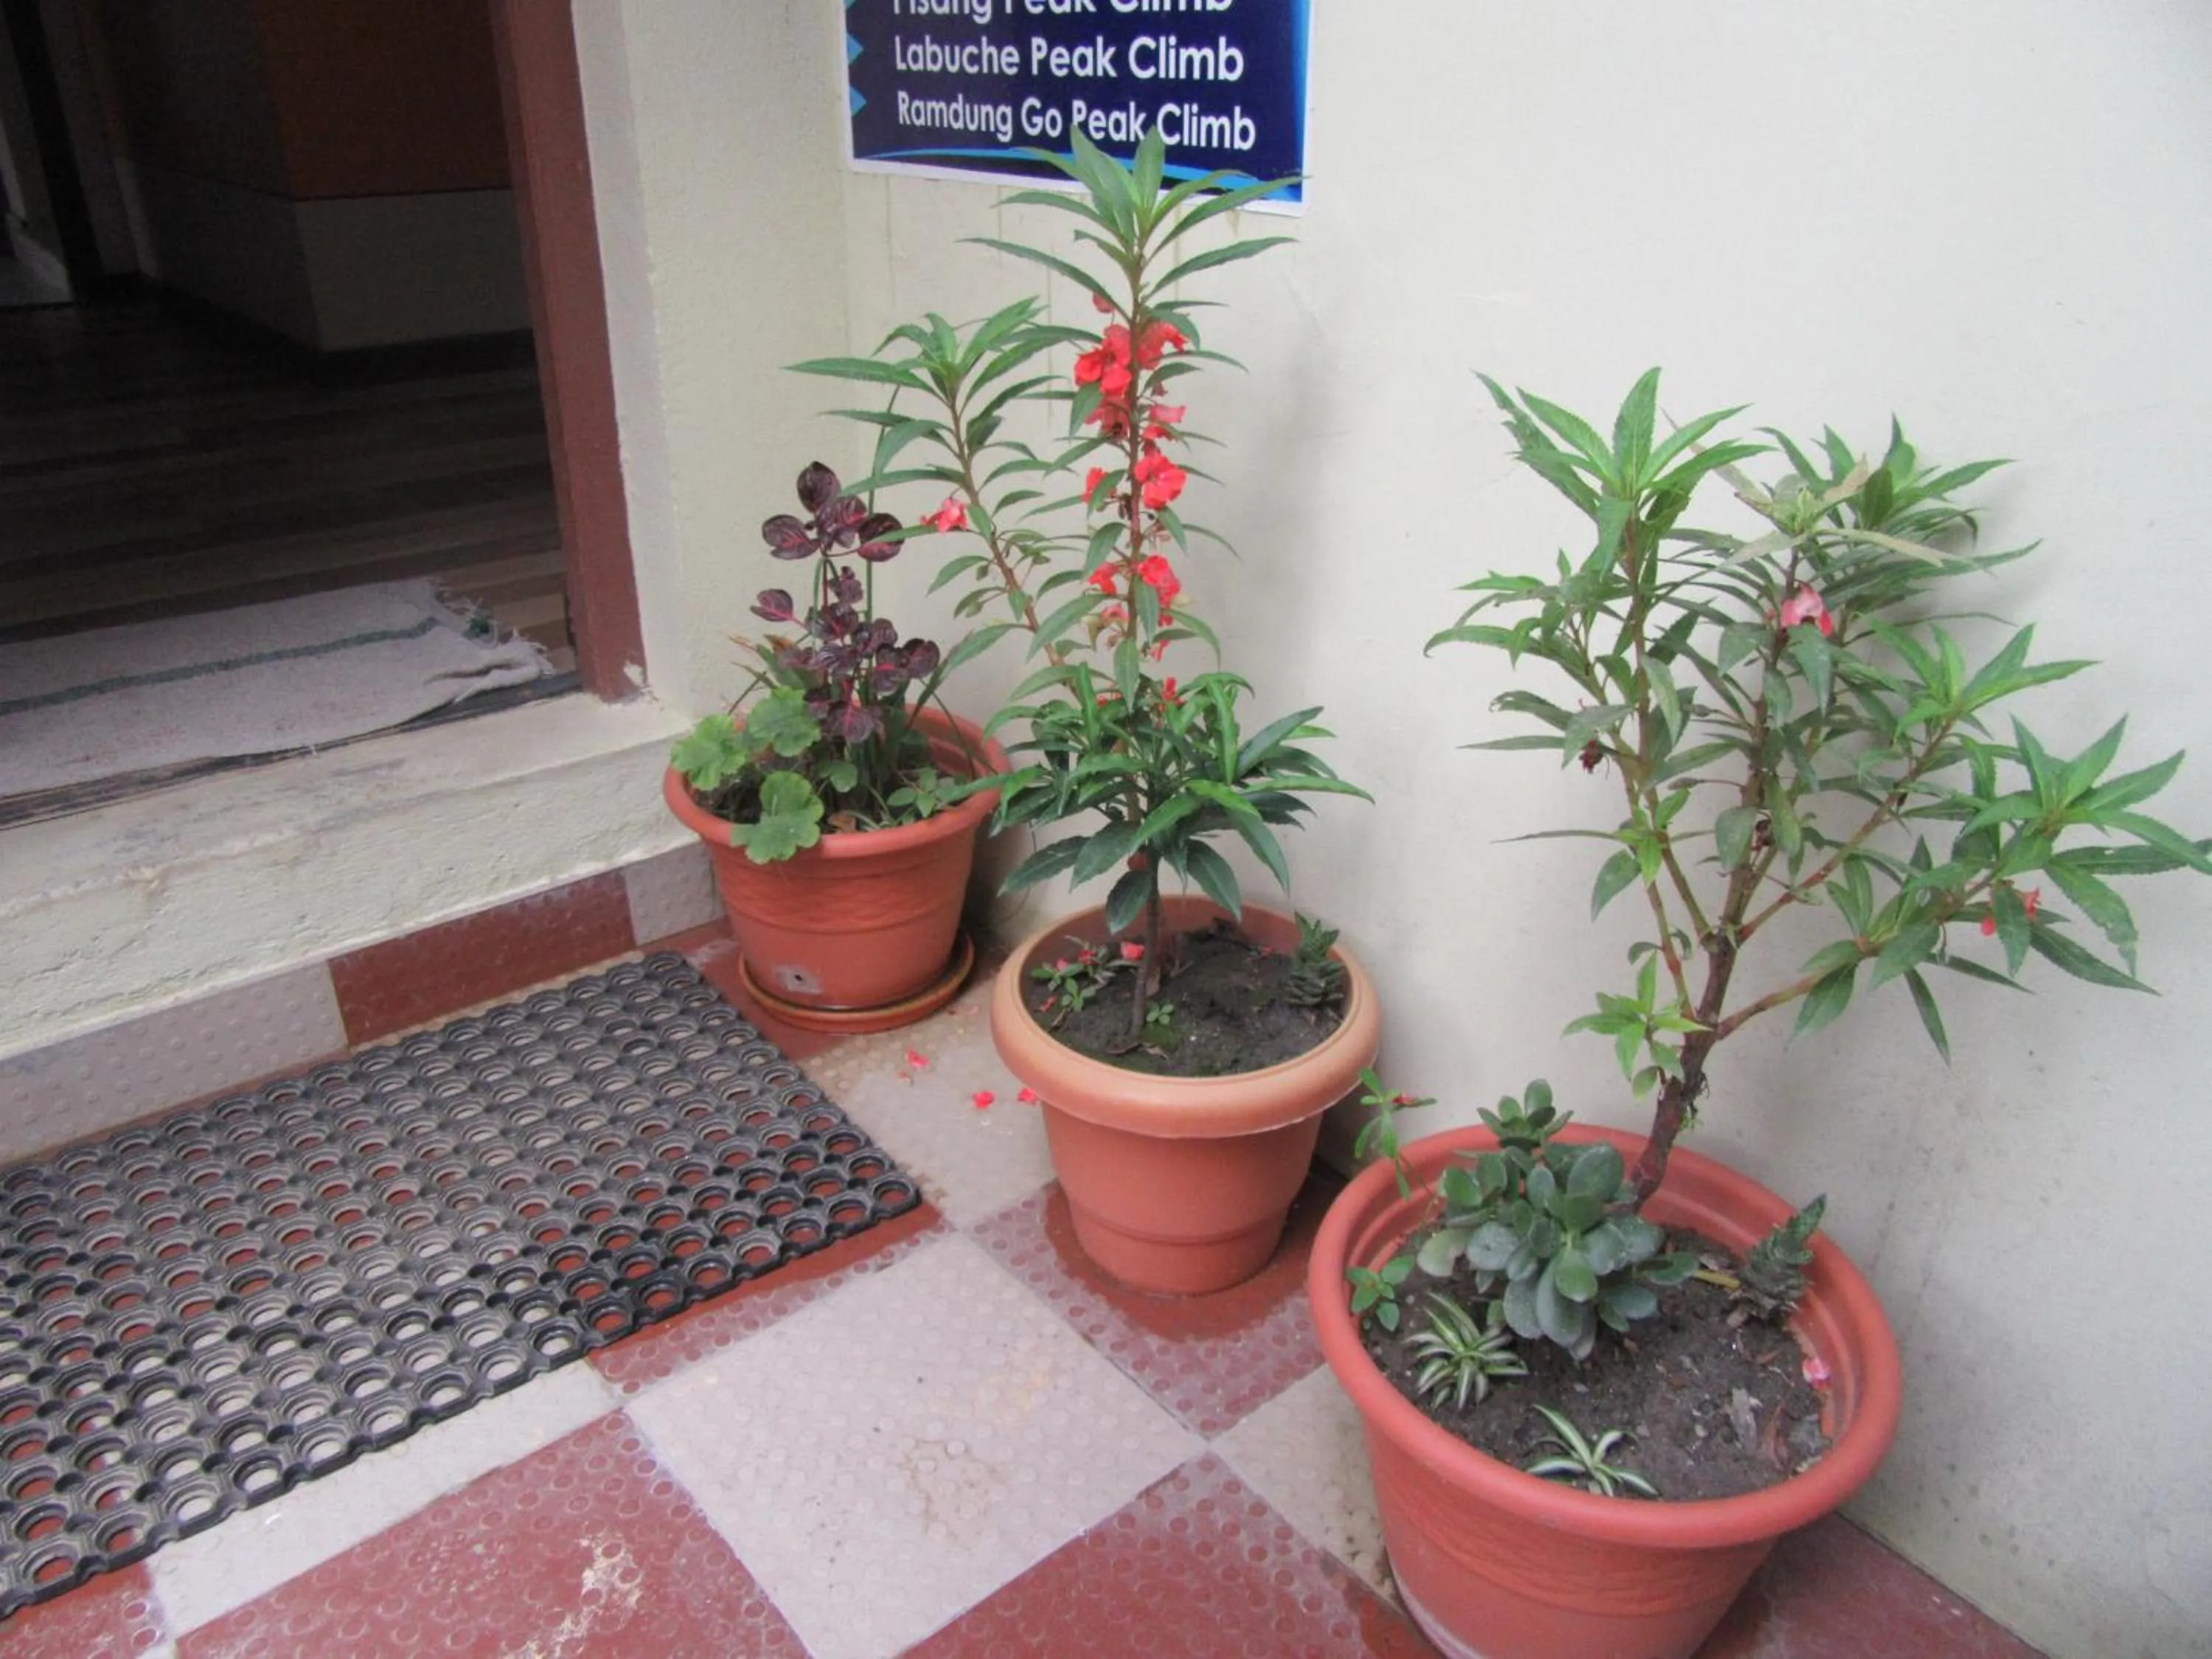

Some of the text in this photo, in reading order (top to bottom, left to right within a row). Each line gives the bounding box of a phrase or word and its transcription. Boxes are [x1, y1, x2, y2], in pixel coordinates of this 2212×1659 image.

[894, 35, 1245, 81] Labuche Peak Climb
[897, 91, 1256, 150] Ramdung Go Peak Climb
